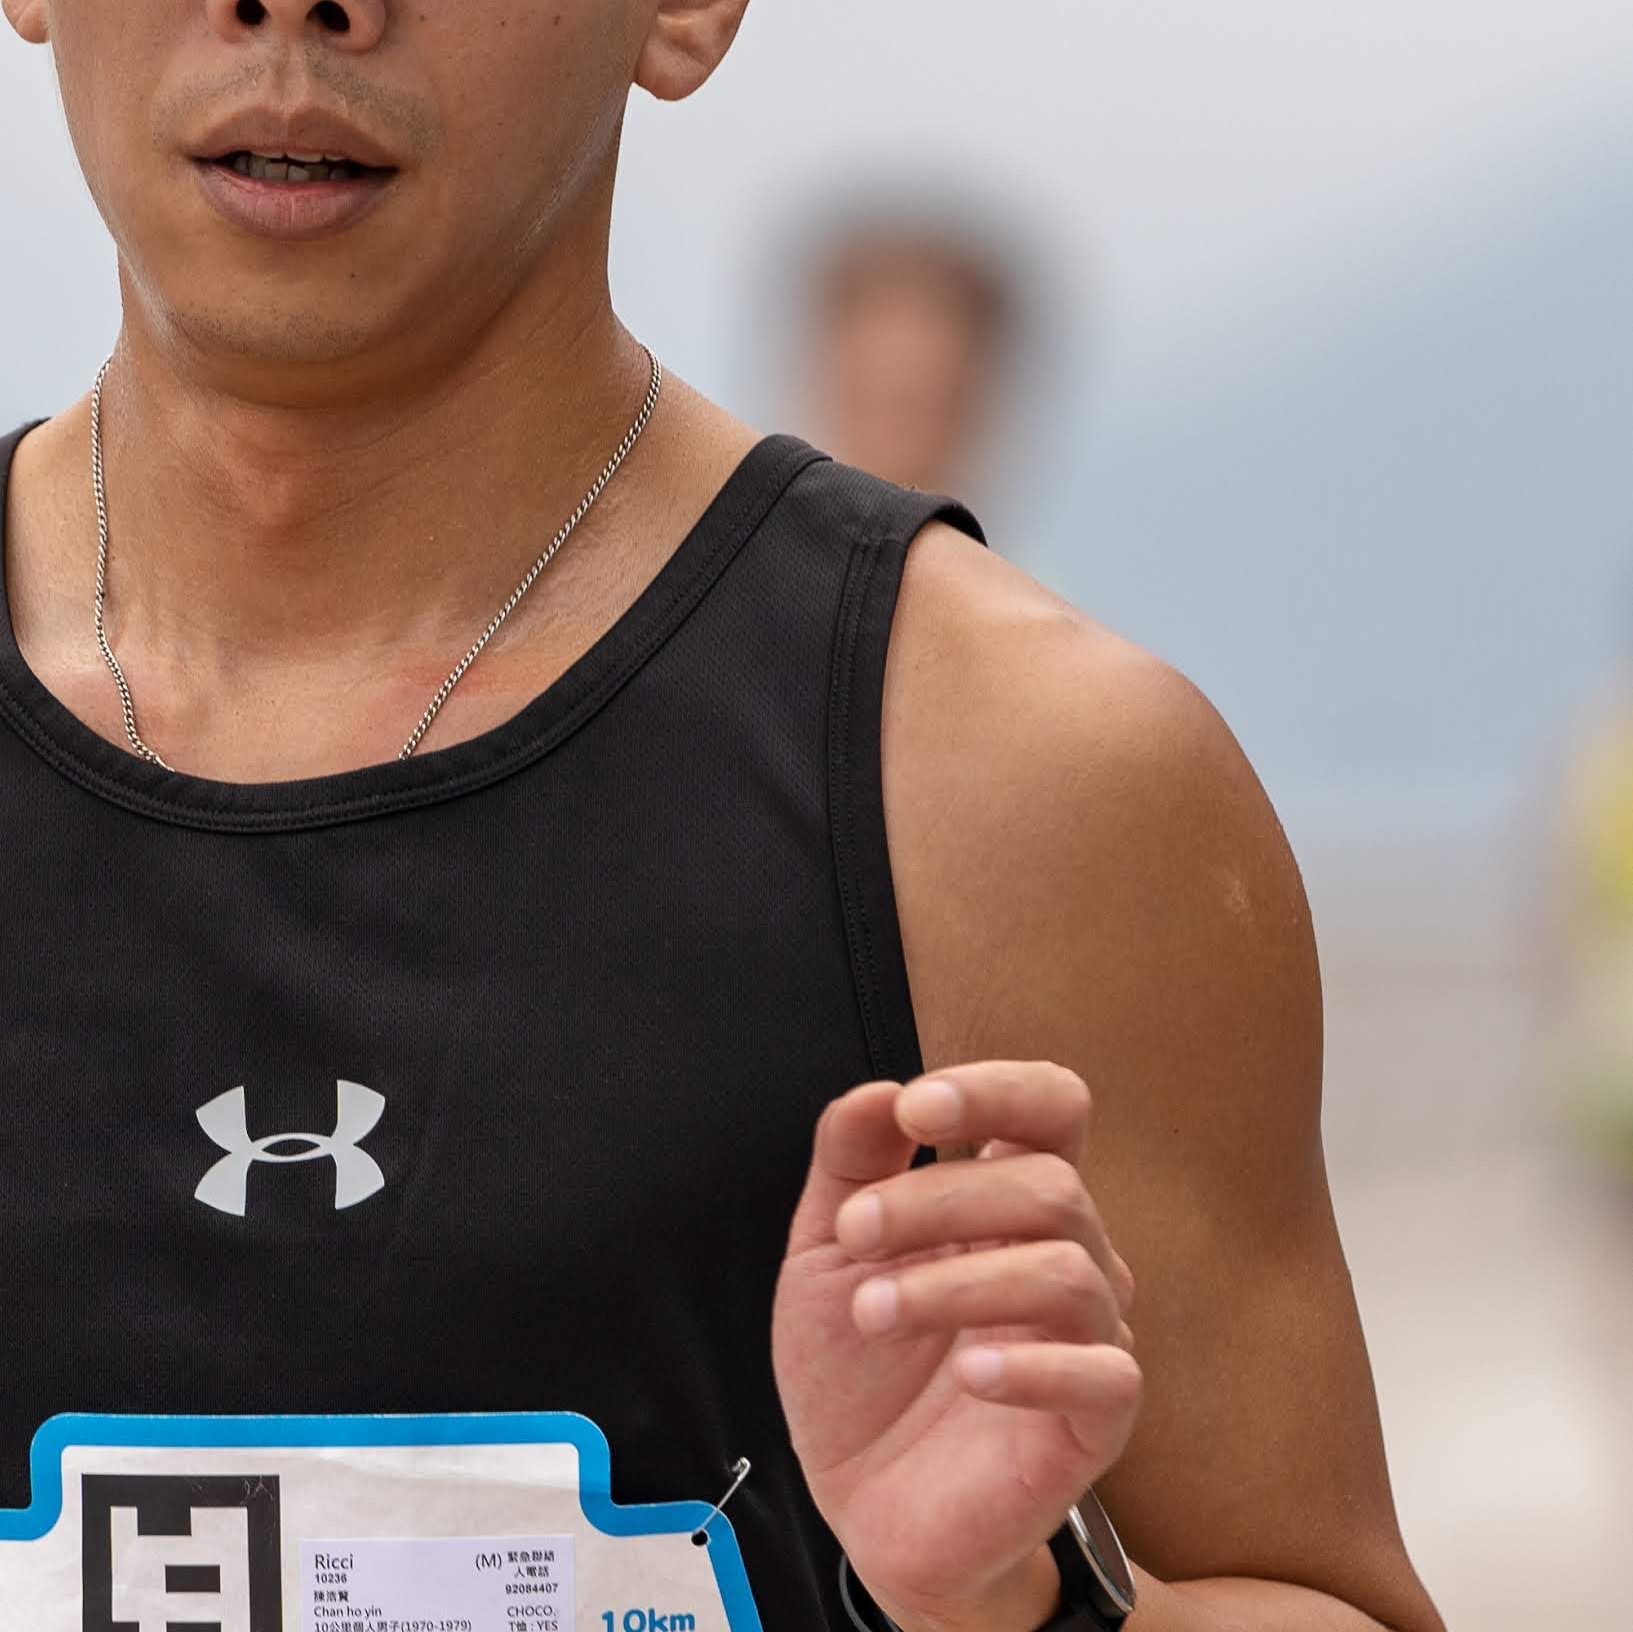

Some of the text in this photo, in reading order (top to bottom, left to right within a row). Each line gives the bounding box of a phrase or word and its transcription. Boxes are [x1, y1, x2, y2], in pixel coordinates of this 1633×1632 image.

[314, 1553, 502, 1571] Ricci (M)
[315, 1573, 348, 1584] 10236
[505, 1583, 558, 1595] 92084407
[314, 1605, 382, 1620] Chan ho yin
[537, 1620, 558, 1632] YES
